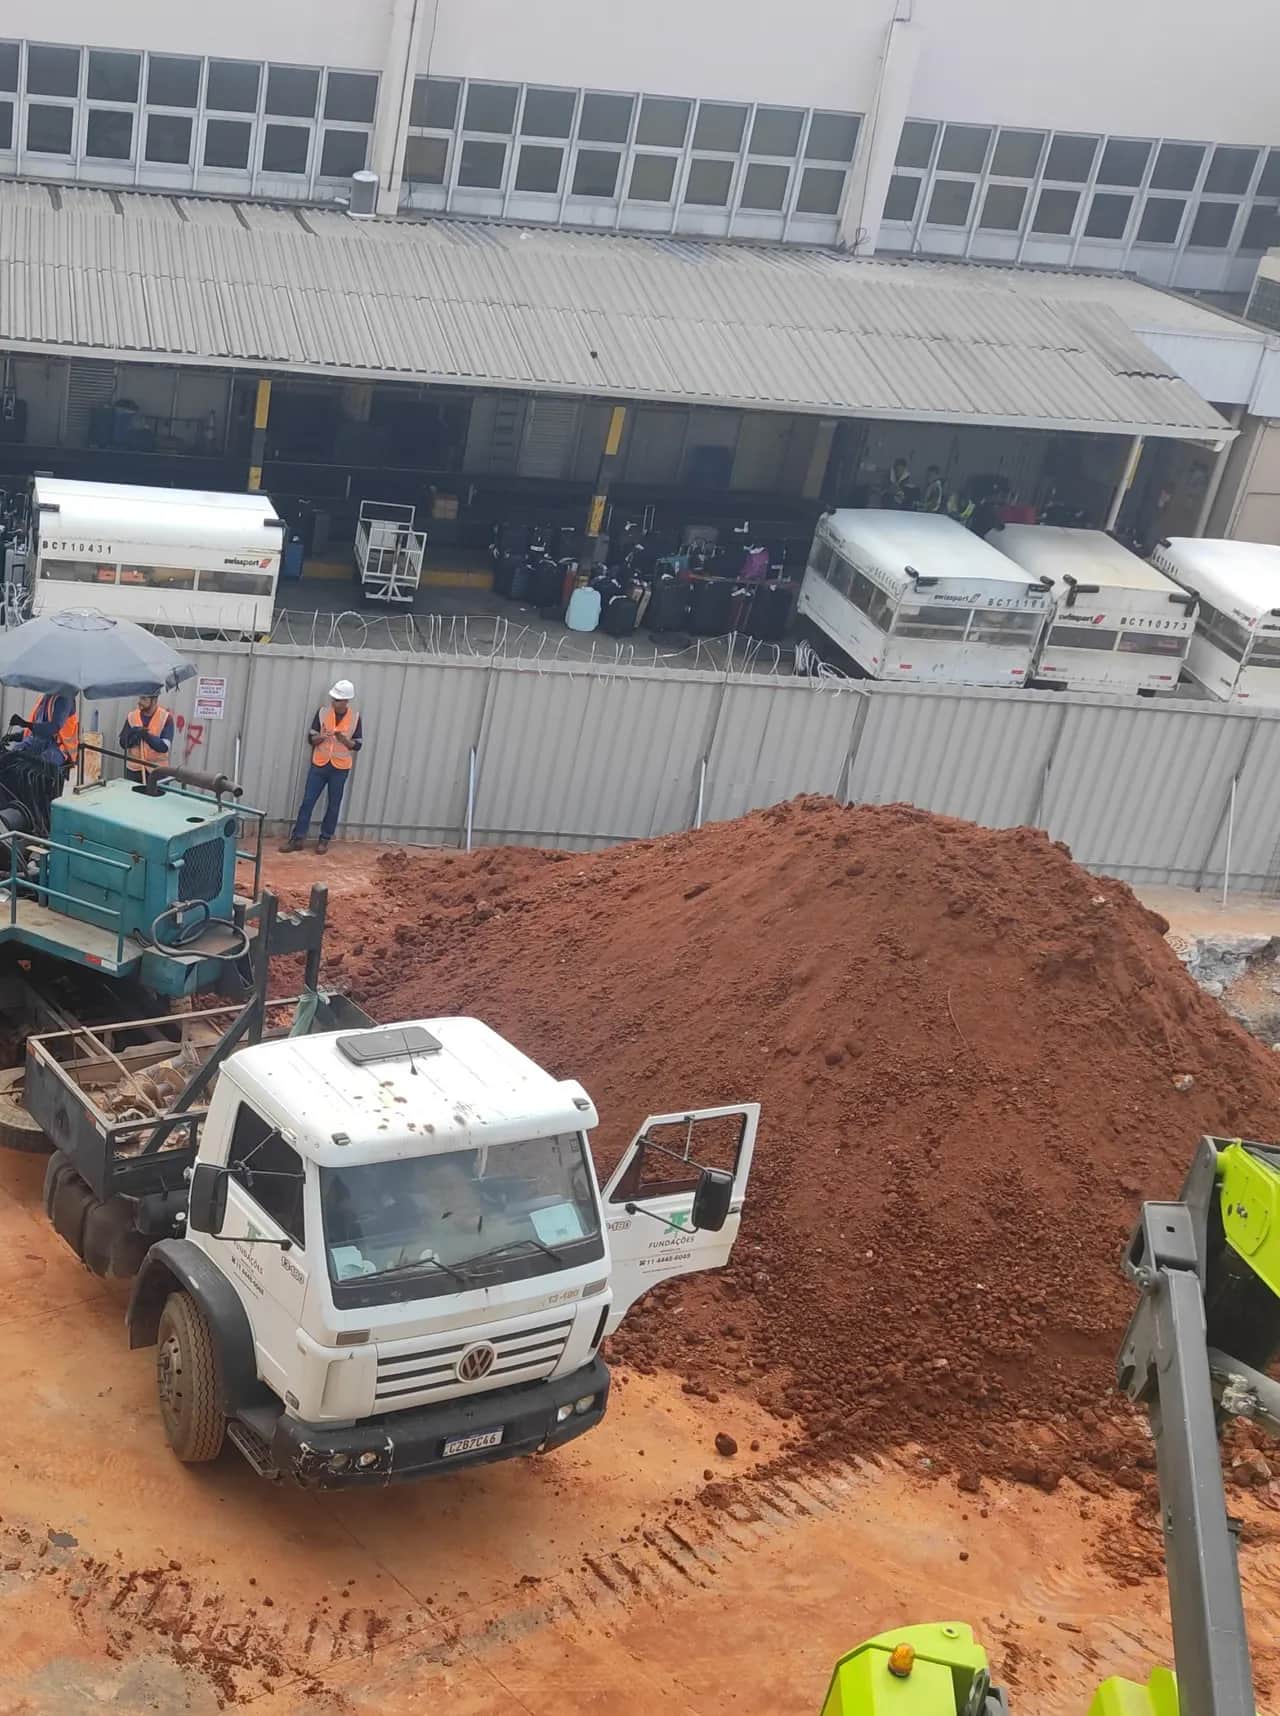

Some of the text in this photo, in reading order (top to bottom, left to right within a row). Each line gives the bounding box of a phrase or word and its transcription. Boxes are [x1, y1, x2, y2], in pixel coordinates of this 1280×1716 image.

[42, 540, 112, 554] BCT10431
[224, 558, 260, 568] swissport
[1058, 614, 1094, 623] swissport
